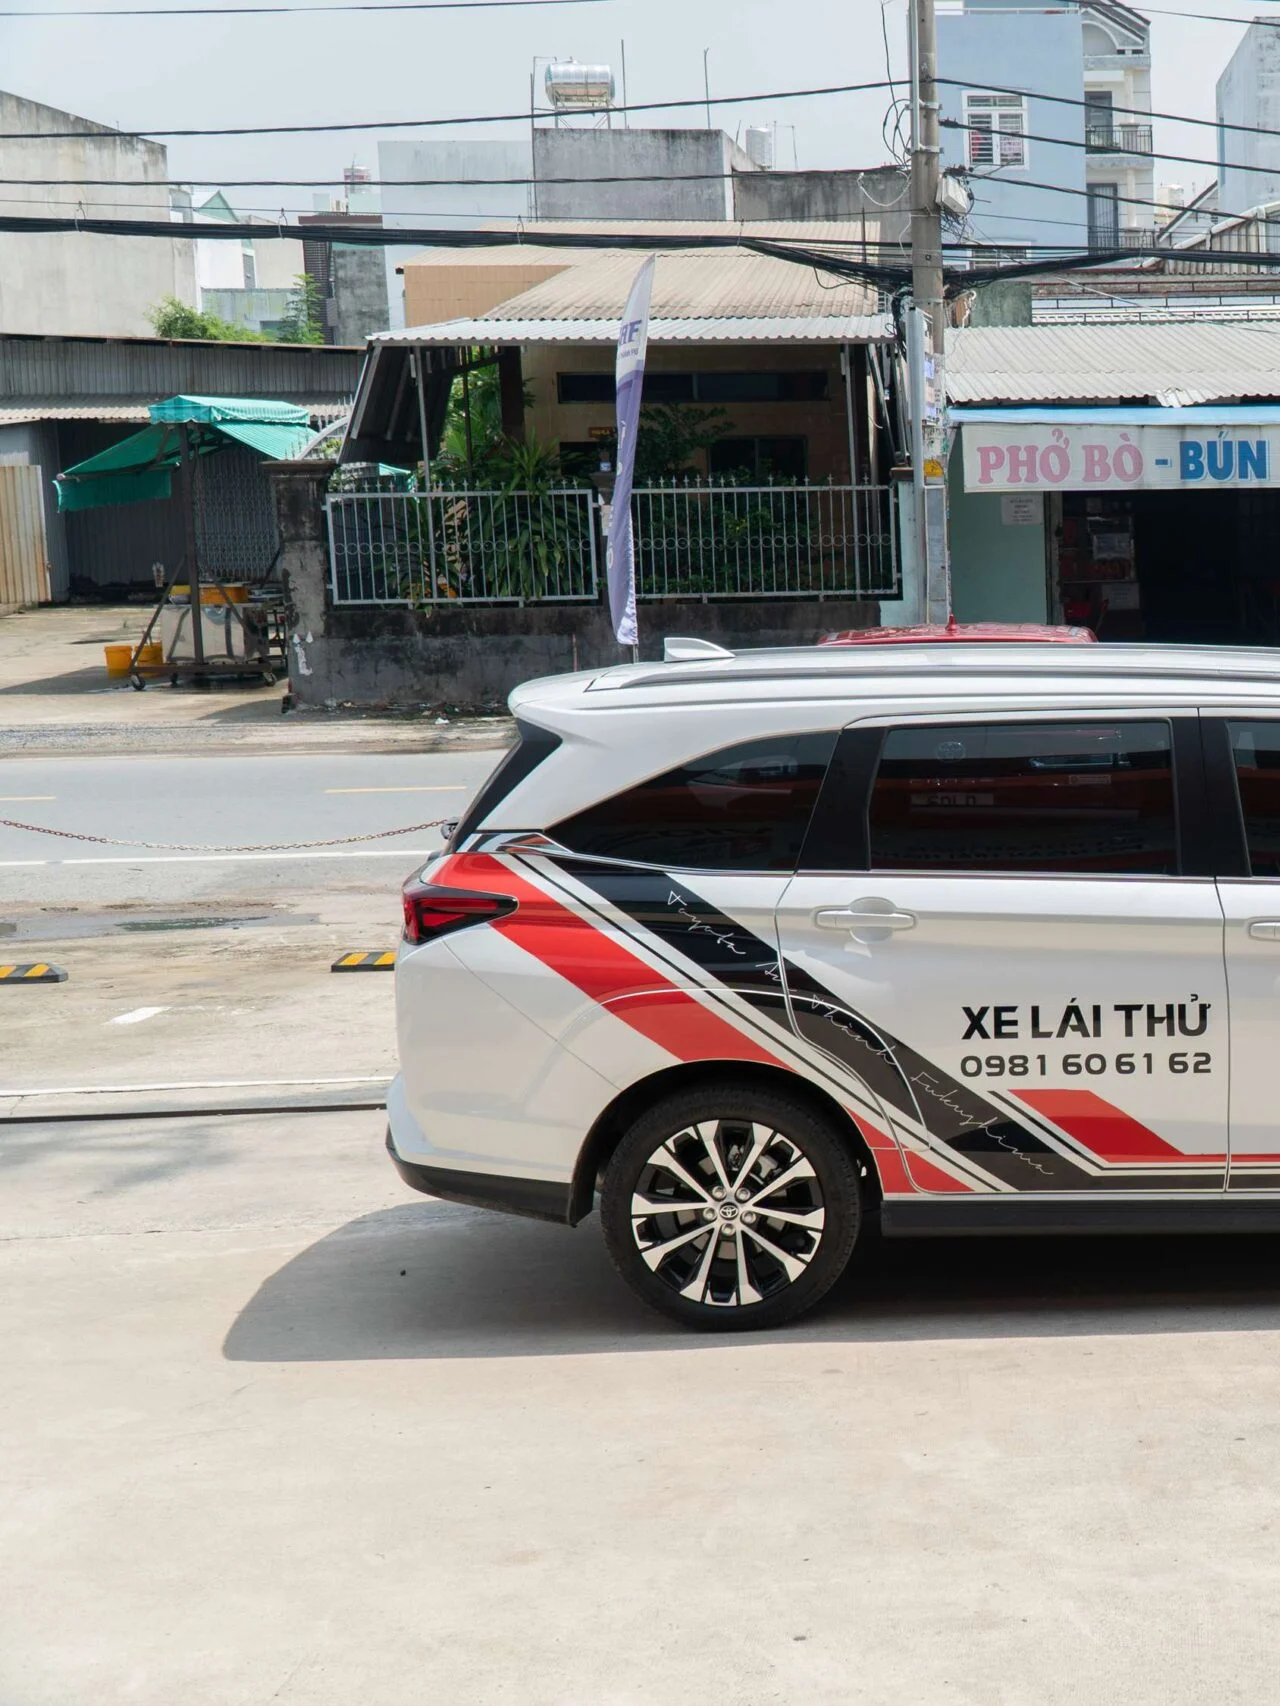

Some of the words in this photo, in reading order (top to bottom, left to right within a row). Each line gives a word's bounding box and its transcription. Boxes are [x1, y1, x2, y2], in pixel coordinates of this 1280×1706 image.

[620, 320, 642, 345] AF
[976, 428, 1070, 484] PHỞ
[1081, 432, 1144, 482] BÒ
[1179, 431, 1268, 481] BÚN
[961, 1005, 1019, 1040] XE
[1031, 997, 1101, 1039] LÁI
[1114, 993, 1212, 1037] THỬ
[960, 1054, 1047, 1077] 0981
[1168, 1052, 1212, 1074] 62
